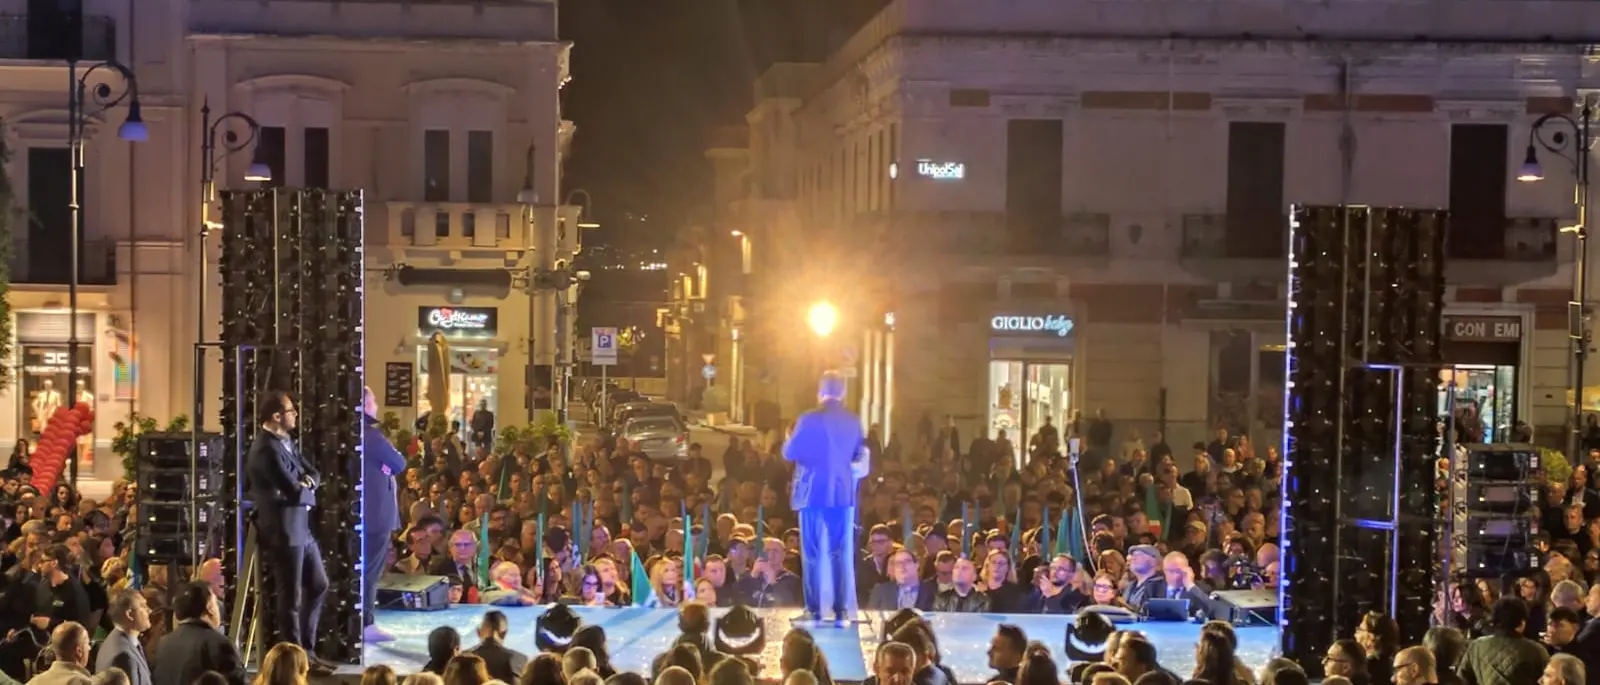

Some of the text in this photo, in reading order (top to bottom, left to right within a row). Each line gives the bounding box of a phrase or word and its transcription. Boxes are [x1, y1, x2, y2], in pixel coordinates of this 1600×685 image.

[991, 316, 1043, 330] GIGLIO
[1454, 321, 1486, 338] CON
[600, 335, 609, 347] P
